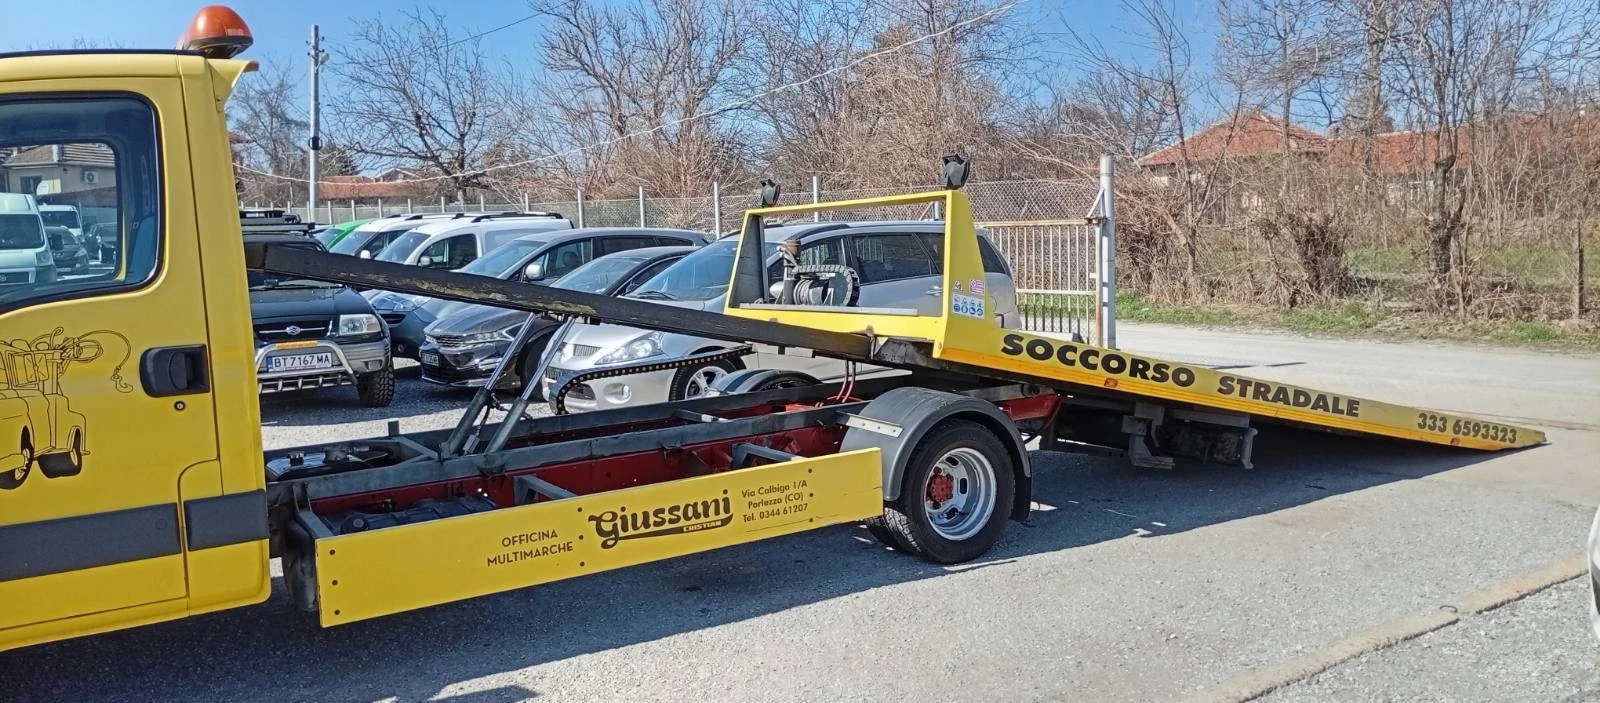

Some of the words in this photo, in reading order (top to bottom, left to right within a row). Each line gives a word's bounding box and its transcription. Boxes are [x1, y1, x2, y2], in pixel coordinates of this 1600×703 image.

[1000, 333, 1196, 387] SOCCORSO
[1217, 375, 1361, 417] STRADALE
[1417, 413, 1447, 432] 333
[1452, 419, 1517, 443] 6593323
[741, 489, 756, 498] Via
[758, 483, 790, 495] Calbiga
[793, 479, 808, 489] 1/A
[784, 491, 804, 505] (CO)
[587, 489, 731, 549] Giussani
[742, 512, 757, 523] Tel.
[759, 508, 780, 519] 0344
[782, 502, 809, 515] 61207
[683, 520, 722, 532] CRISTIAN
[501, 529, 559, 548] OFFICINA
[487, 541, 574, 567] MULTIMARCHE
